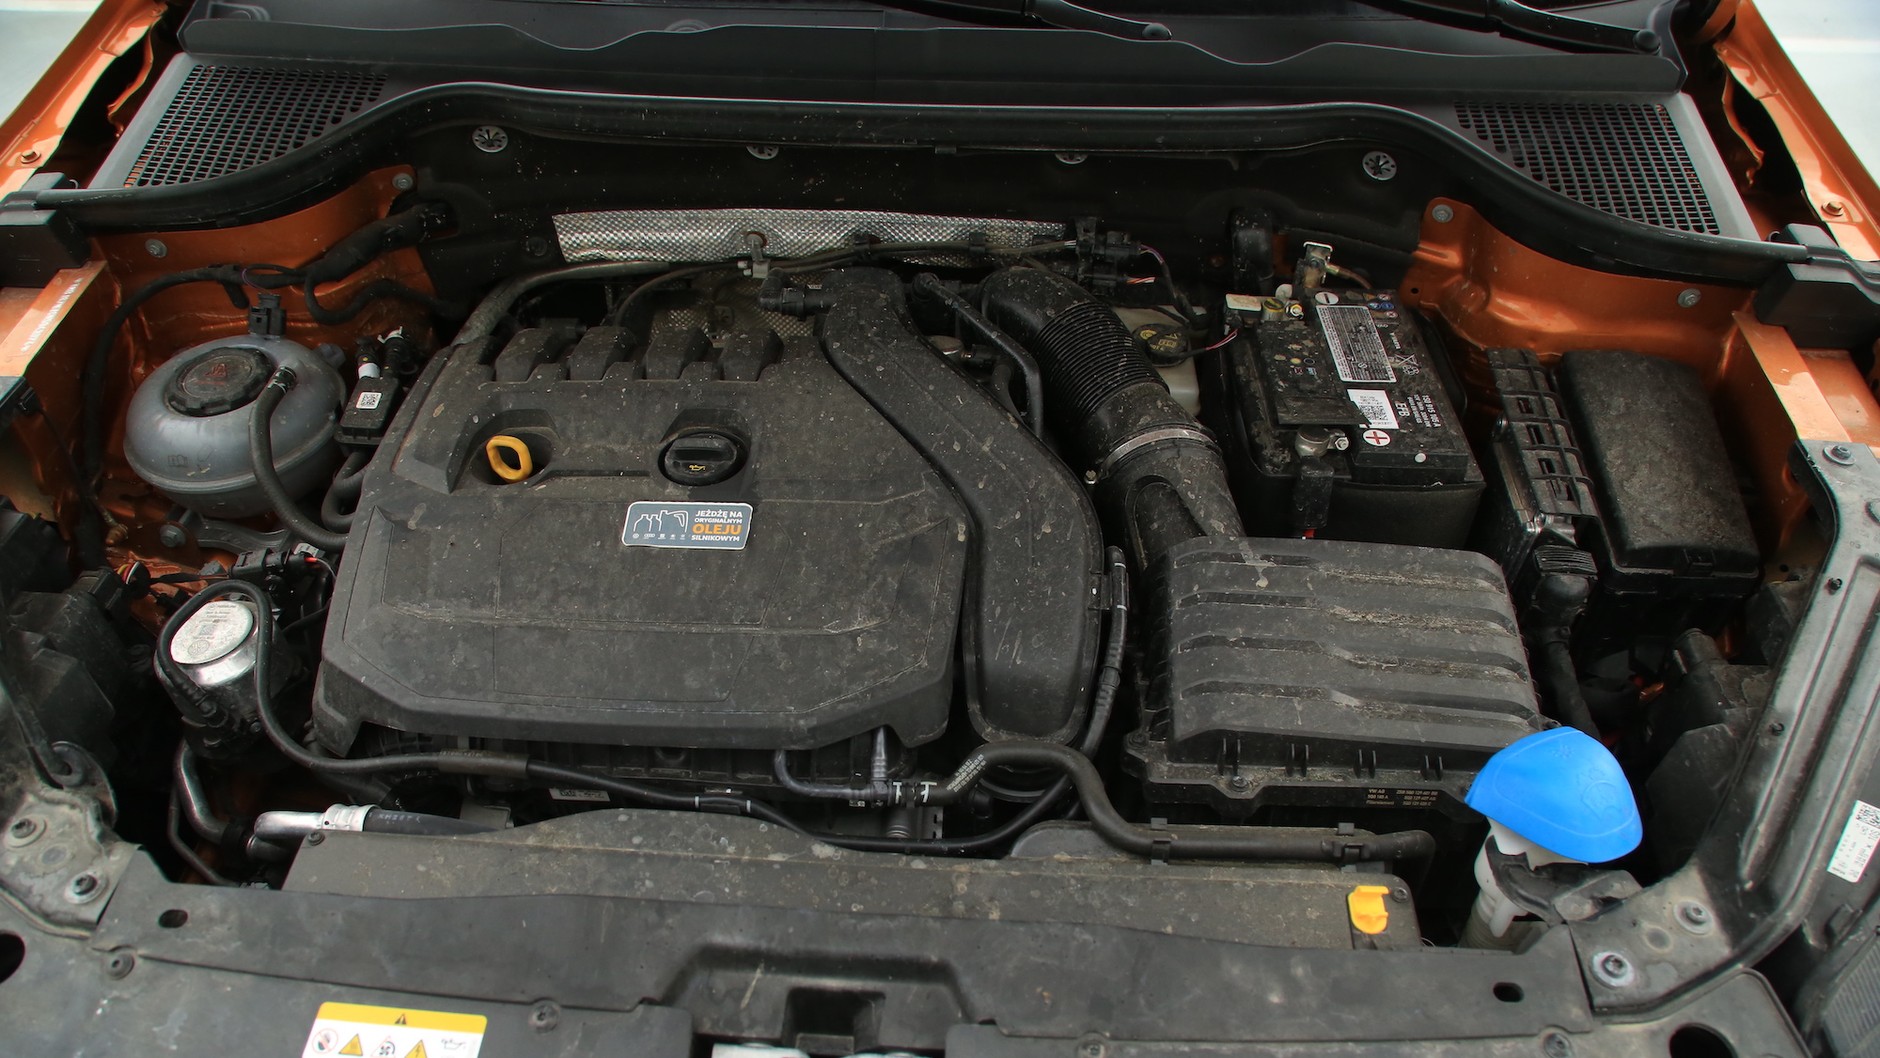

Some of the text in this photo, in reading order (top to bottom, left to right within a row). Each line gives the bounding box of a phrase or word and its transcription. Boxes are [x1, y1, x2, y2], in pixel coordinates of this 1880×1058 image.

[1394, 401, 1410, 417] EFB
[695, 509, 727, 519] JEŻDŻĘ
[692, 524, 742, 535] OLEJU
